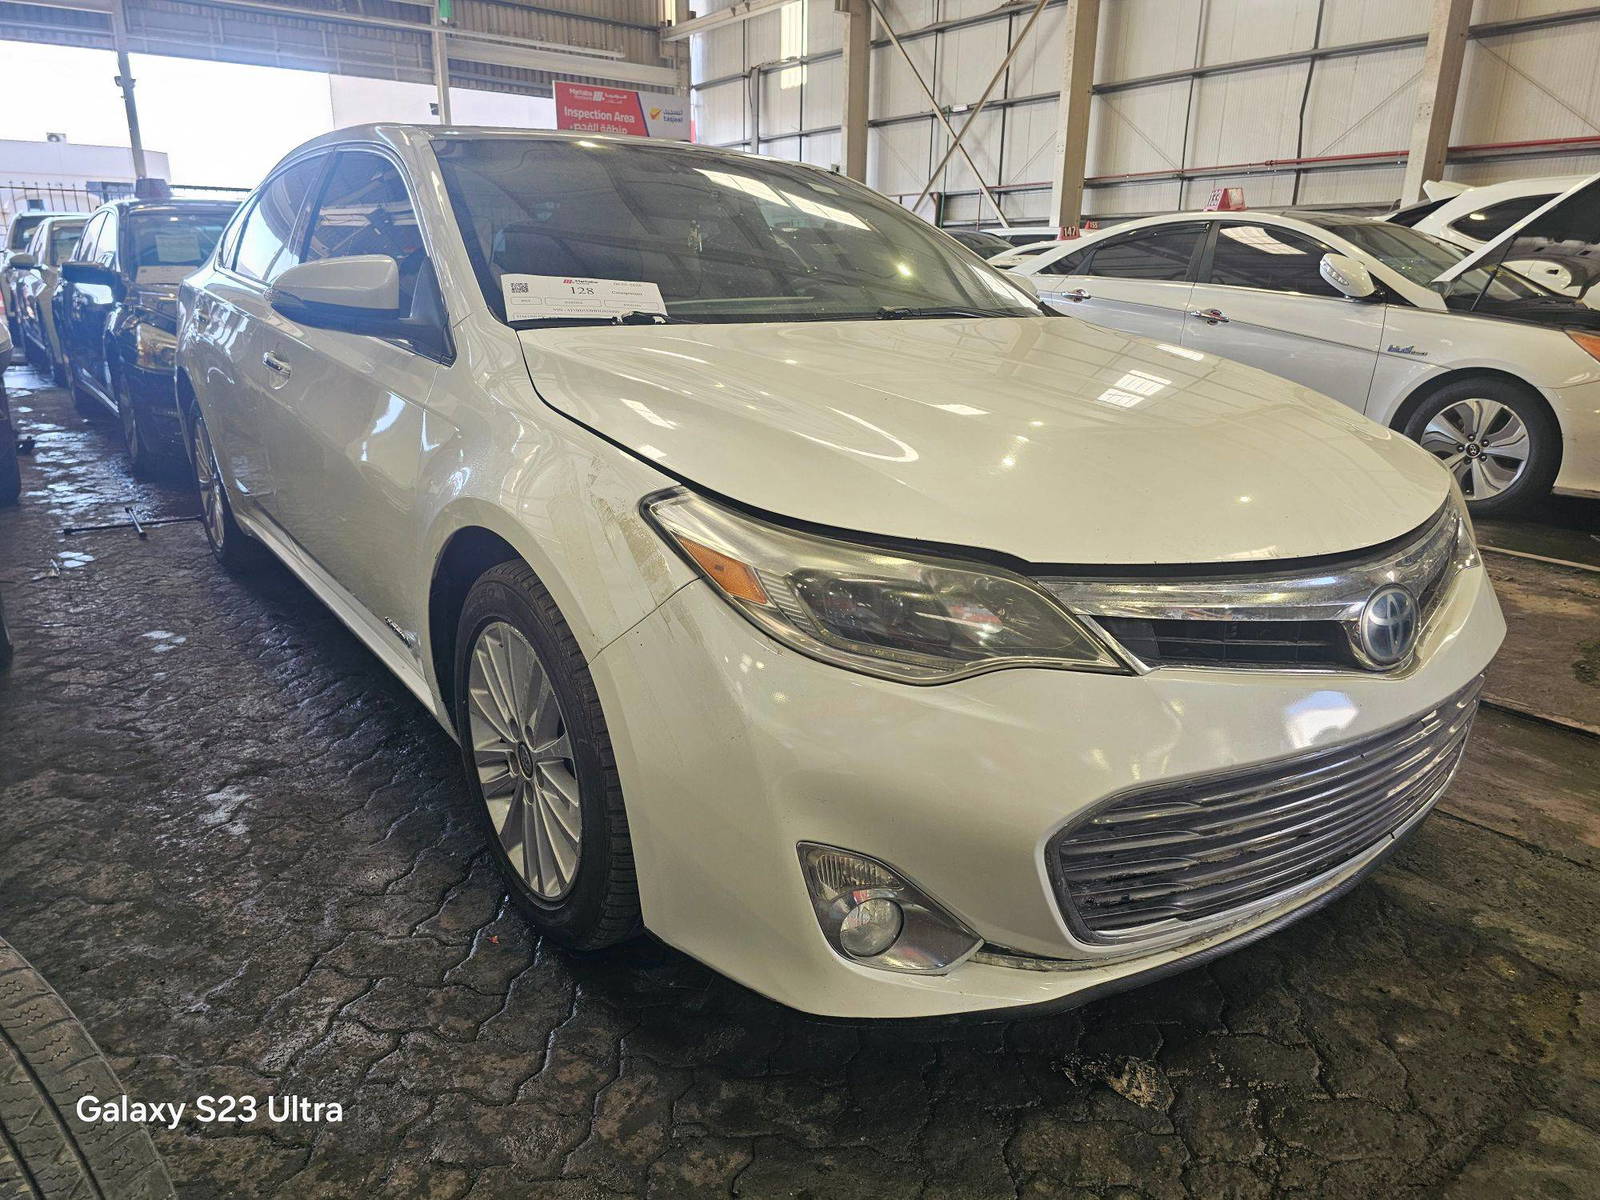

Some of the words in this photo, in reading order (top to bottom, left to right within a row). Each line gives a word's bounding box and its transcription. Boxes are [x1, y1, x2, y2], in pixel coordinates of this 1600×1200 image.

[564, 106, 612, 121] Inspection
[614, 111, 635, 123] Area
[1064, 225, 1077, 237] 147
[570, 286, 595, 296] 128
